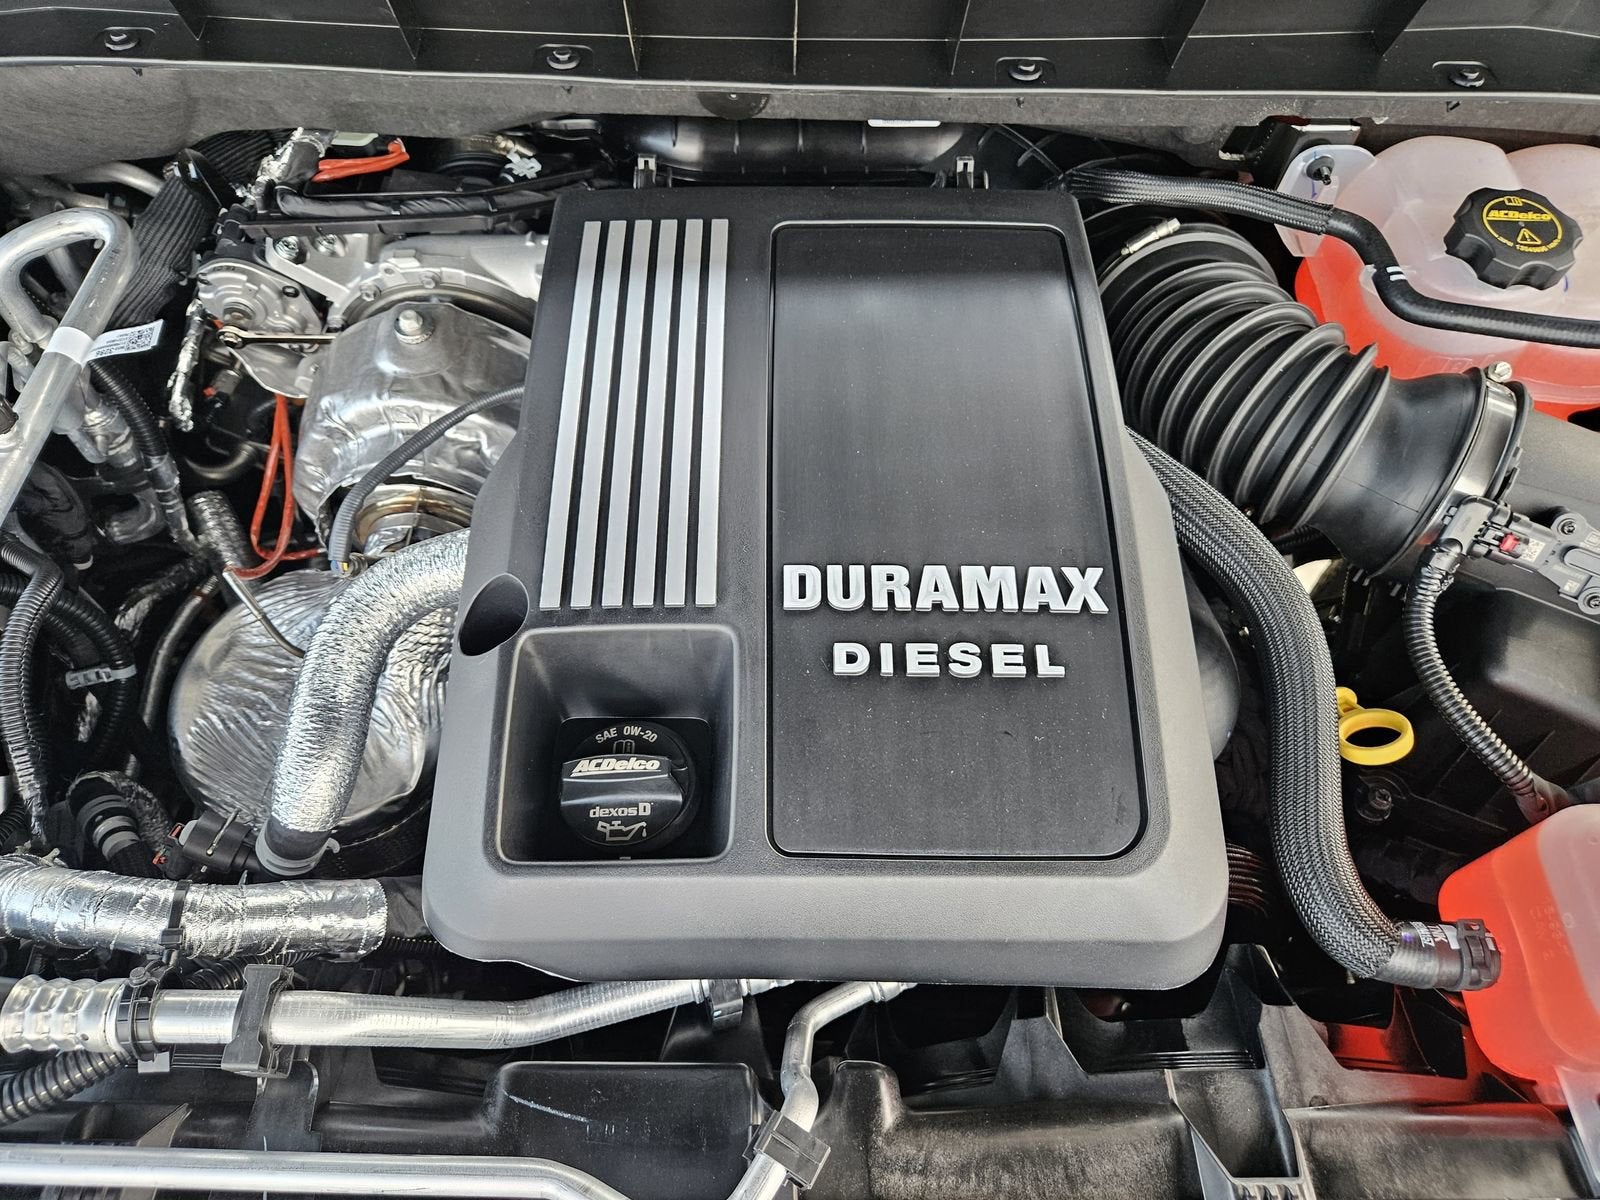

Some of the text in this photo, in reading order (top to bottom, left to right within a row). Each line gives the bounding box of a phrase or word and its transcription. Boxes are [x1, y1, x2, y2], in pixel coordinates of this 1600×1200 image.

[1487, 209, 1552, 220] ACDelco
[783, 564, 1109, 614] DURAMAX
[832, 642, 1066, 678] DIESEL
[595, 725, 658, 743] SAE 0W-20
[571, 757, 661, 774] ACDelco
